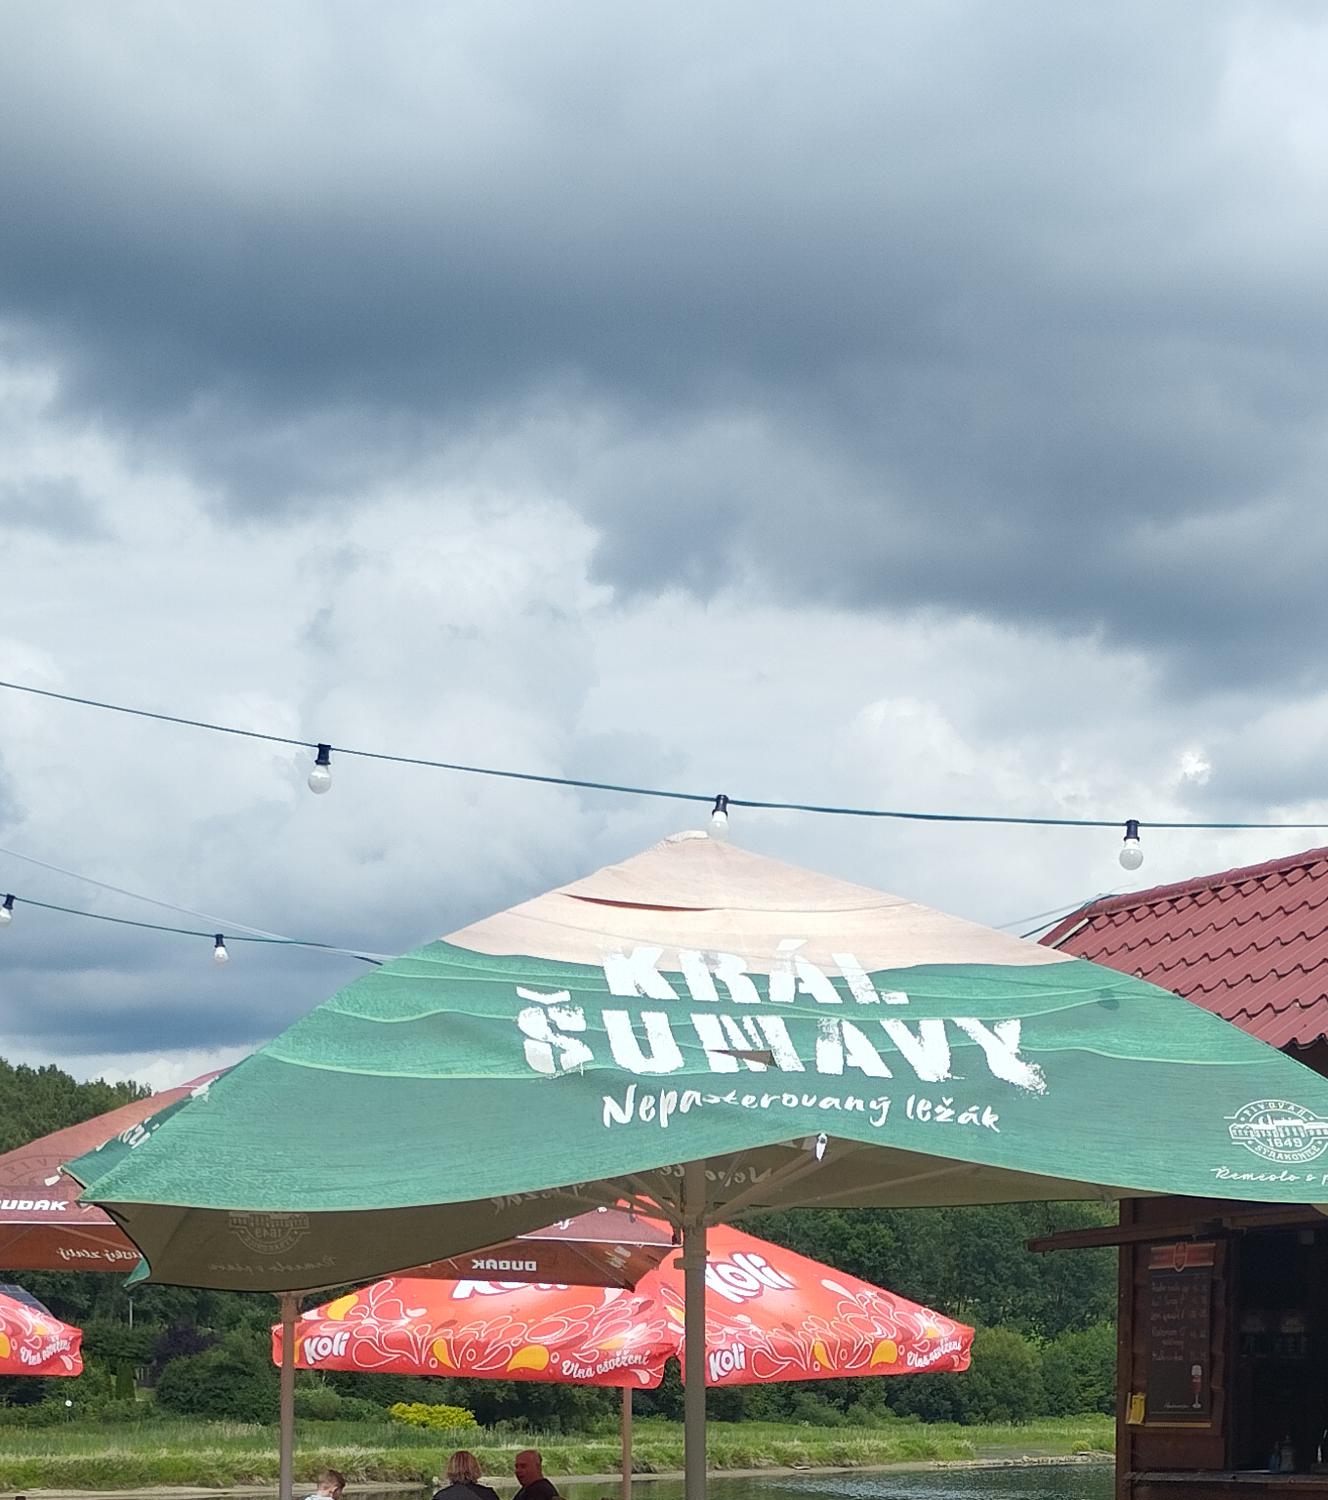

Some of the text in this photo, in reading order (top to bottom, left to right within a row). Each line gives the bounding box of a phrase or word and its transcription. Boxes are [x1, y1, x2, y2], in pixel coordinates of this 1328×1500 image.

[602, 938, 910, 1006] KRÁL
[517, 986, 1049, 1095] ŠUMAVY
[602, 1085, 1001, 1133] Nepasterovaný ležák
[1243, 1101, 1306, 1117] PIVOVAR
[1253, 1145, 1320, 1161] STRAKONICE
[1267, 1137, 1303, 1148] 1649
[303, 1331, 350, 1366] Koli
[560, 1347, 651, 1378] Vlna osvěžení
[709, 1343, 746, 1382] Koli
